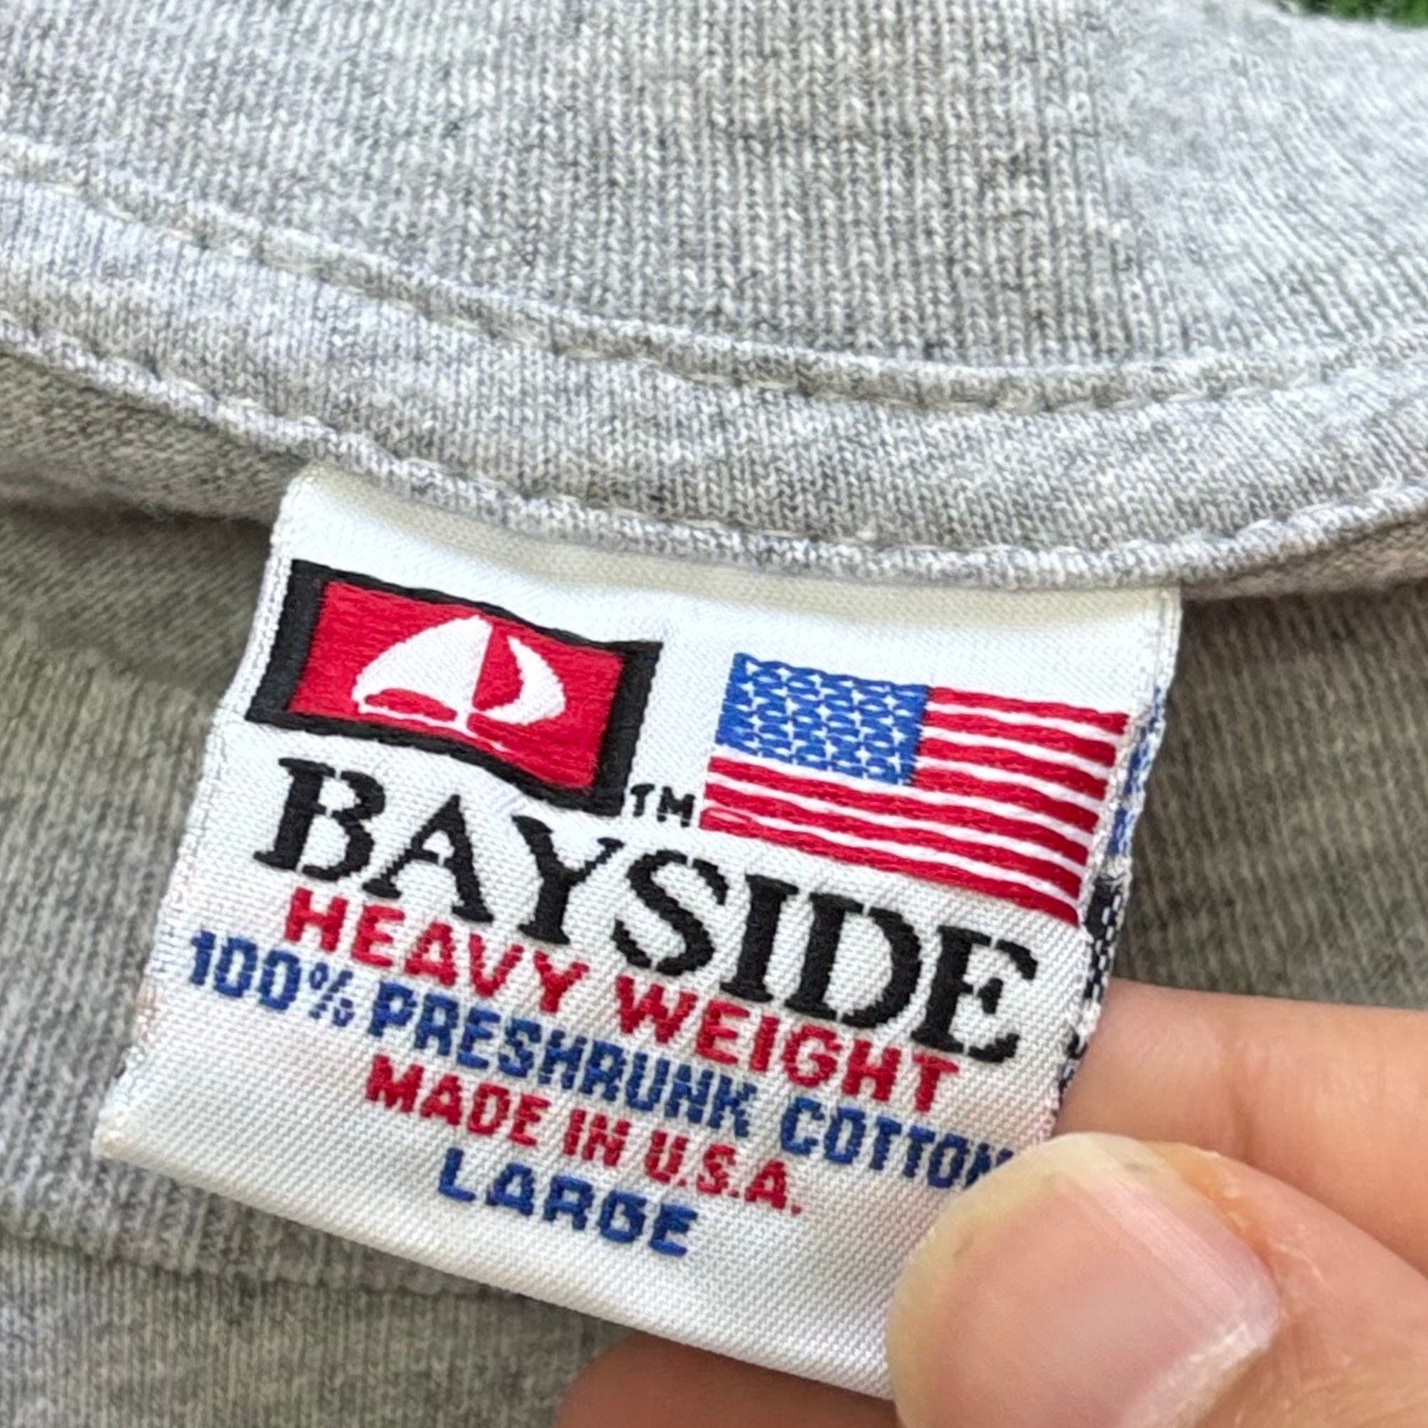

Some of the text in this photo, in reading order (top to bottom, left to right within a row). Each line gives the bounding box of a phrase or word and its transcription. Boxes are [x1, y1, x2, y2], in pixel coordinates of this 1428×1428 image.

[630, 782, 696, 828] TM
[253, 757, 1039, 1064] BAYSIDE
[284, 886, 960, 1113] HEAVY WEIGHT
[188, 929, 356, 1028] 100%
[367, 980, 758, 1138] PRESHRUNK
[365, 1052, 803, 1216] MADE IN U.S.A.
[438, 1146, 699, 1257] LARGE
